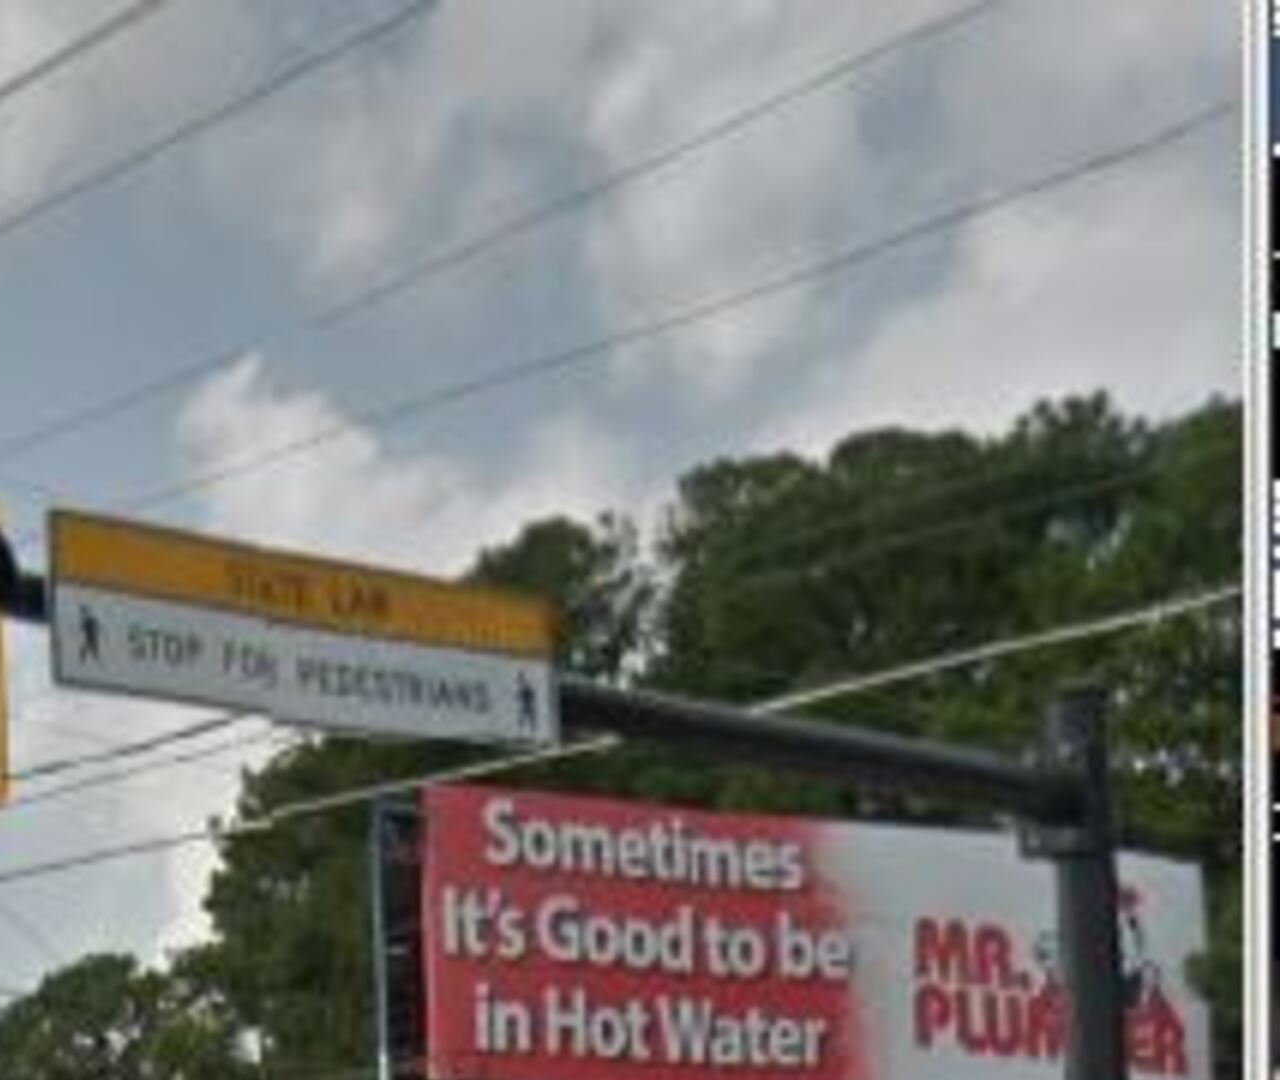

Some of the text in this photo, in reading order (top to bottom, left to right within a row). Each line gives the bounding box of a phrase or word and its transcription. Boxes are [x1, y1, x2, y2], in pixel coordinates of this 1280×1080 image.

[126, 626, 491, 714] STOP FOR PEDESTRIANS
[483, 797, 803, 892] Sometimes
[443, 887, 851, 981] It's Good to be
[914, 916, 1030, 992] MR.
[474, 981, 828, 1067] in Hot Water
[914, 982, 1186, 1074] PLUMER
